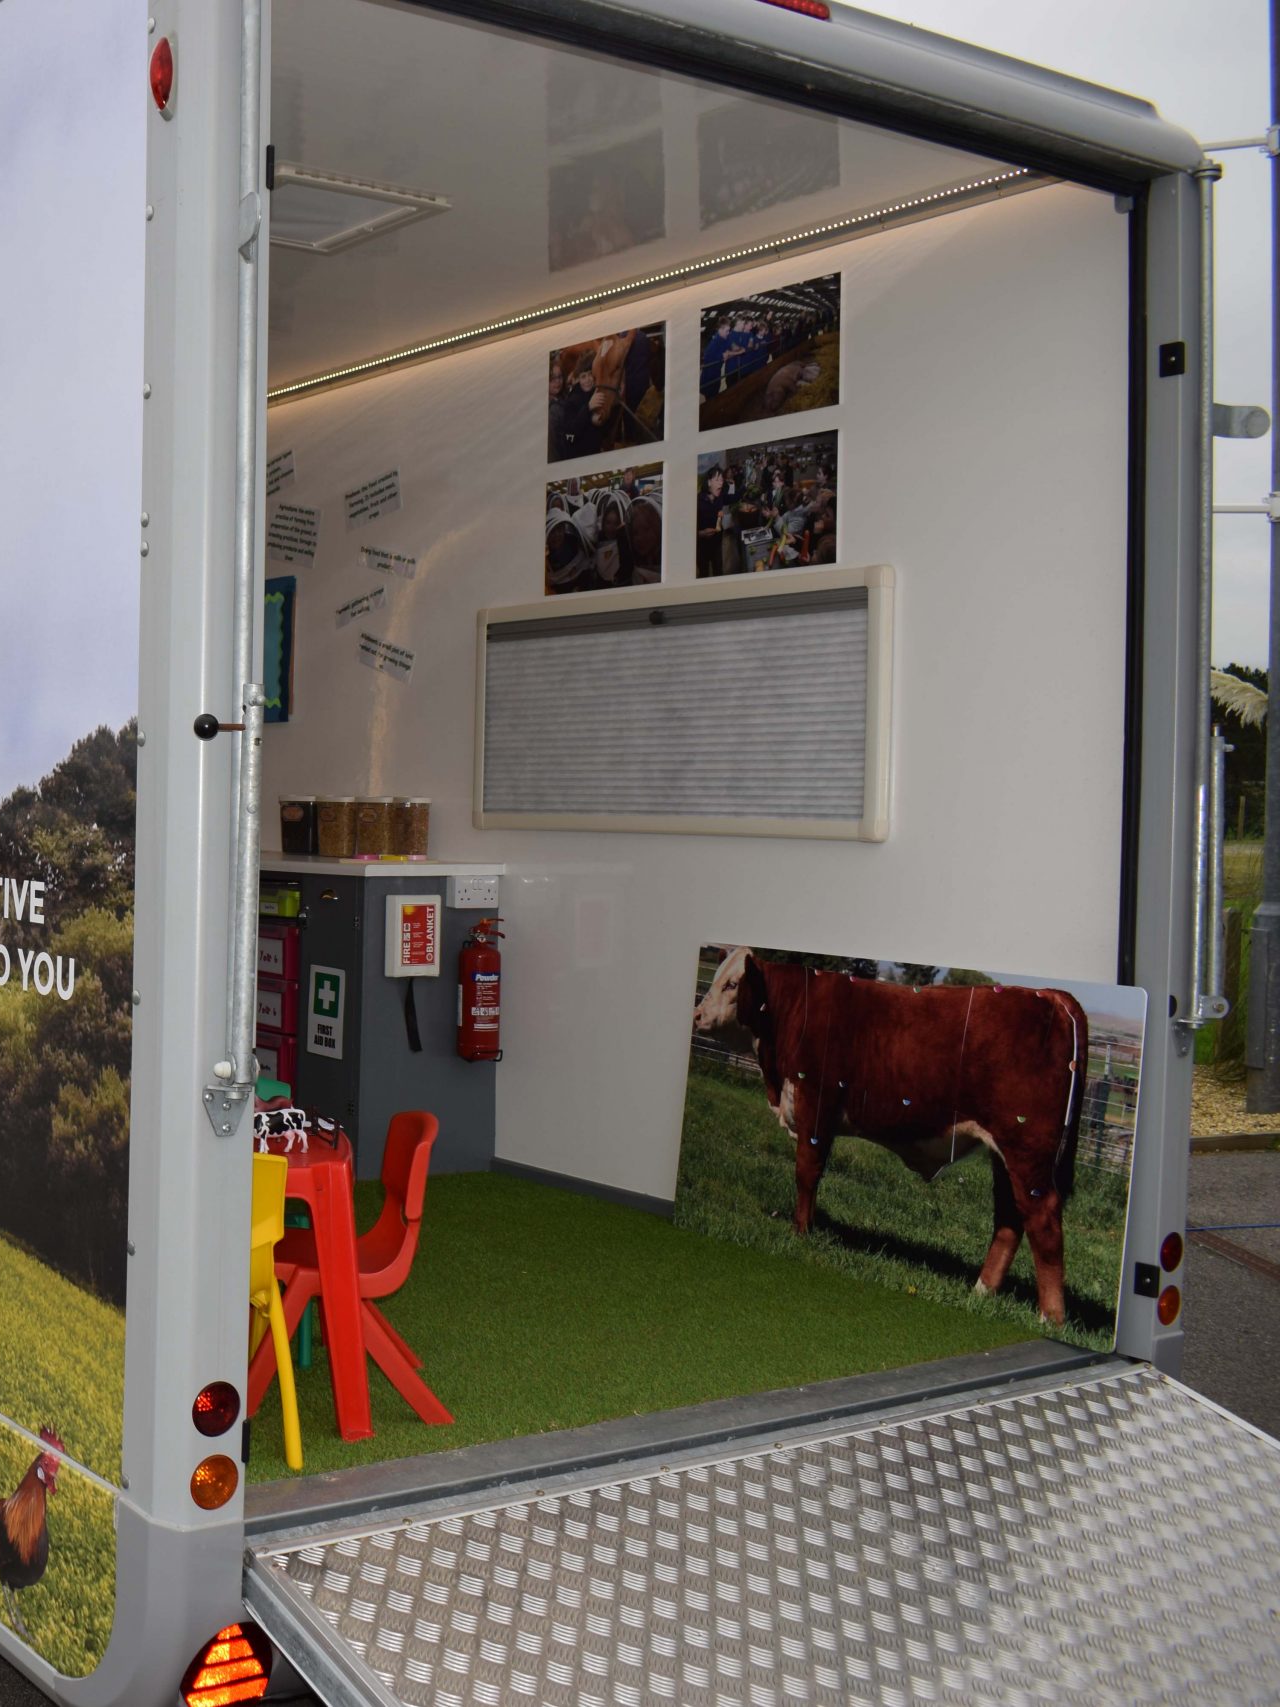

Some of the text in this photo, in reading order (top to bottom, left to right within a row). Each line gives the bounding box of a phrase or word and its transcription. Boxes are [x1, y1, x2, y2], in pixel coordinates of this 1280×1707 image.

[426, 906, 434, 953] BLANKET
[402, 941, 411, 964] FIRE
[18, 947, 76, 1001] YOU
[317, 1023, 333, 1036] FIRST
[313, 1034, 336, 1049] AID BOX
